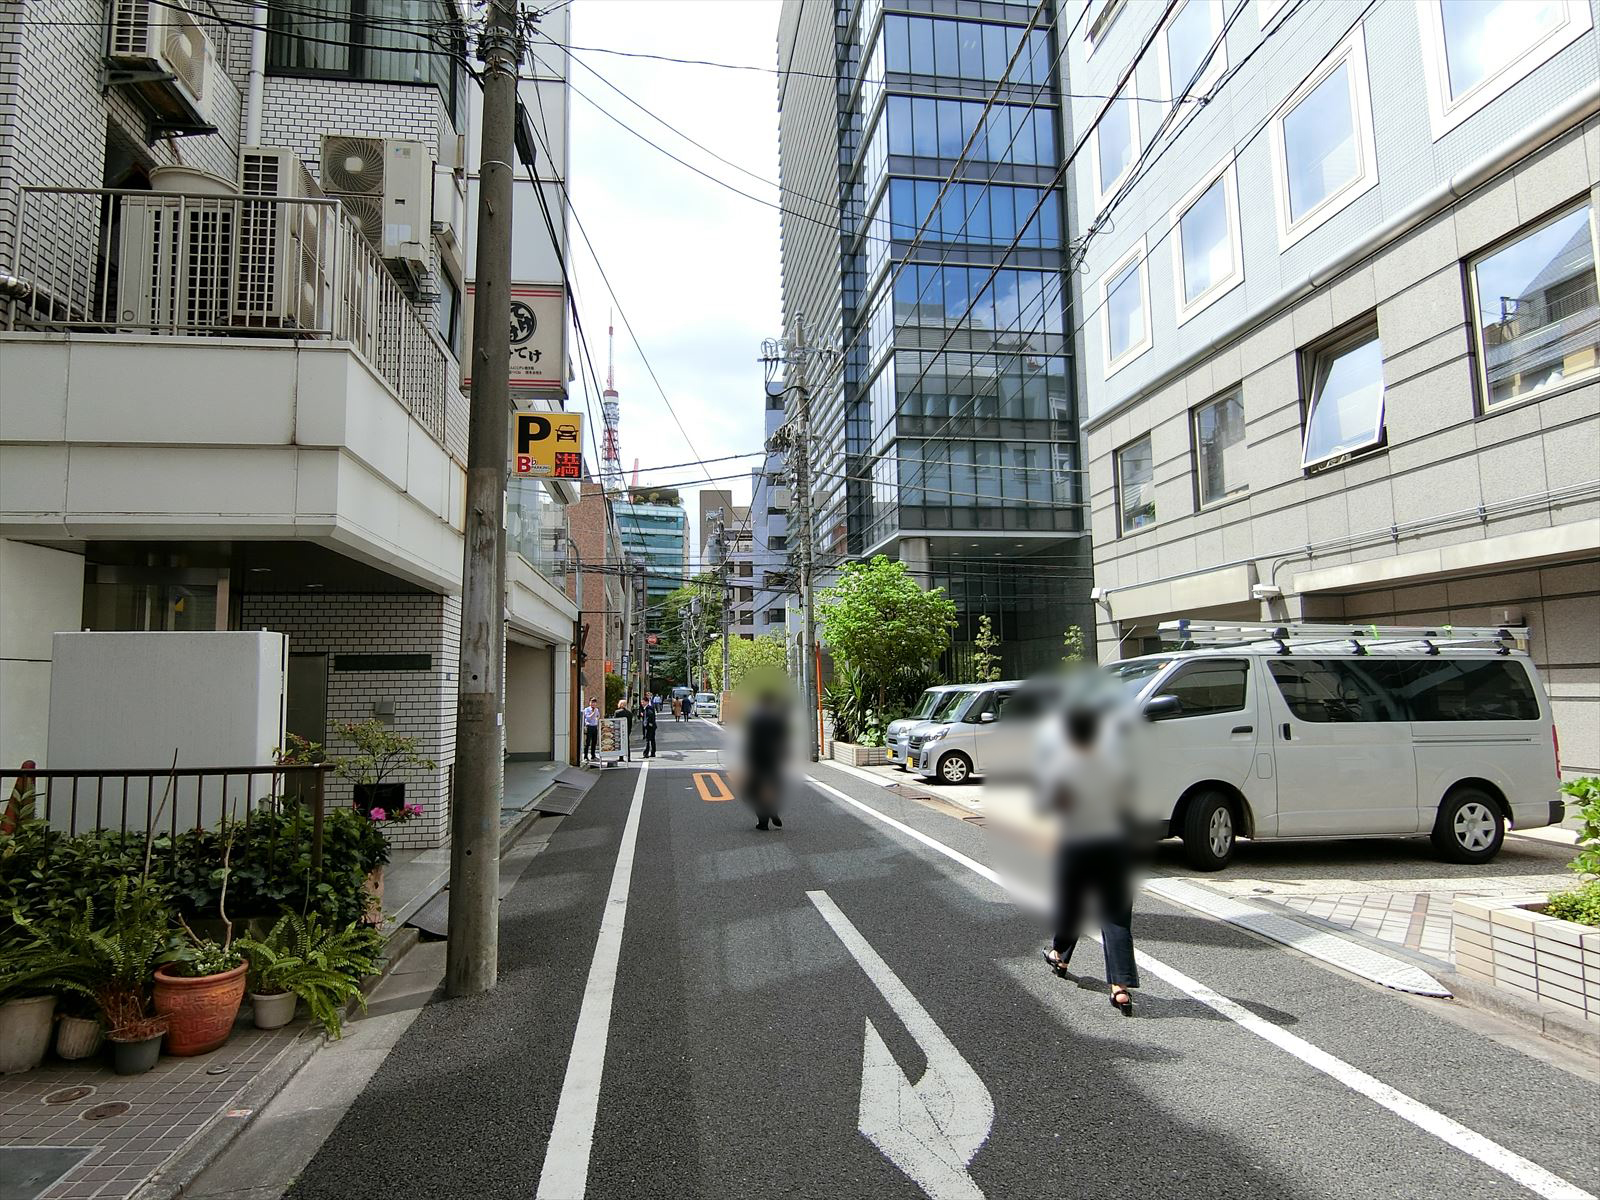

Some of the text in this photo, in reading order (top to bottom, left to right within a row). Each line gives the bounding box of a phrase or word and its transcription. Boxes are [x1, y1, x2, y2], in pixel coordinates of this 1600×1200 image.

[510, 347, 542, 363] てけ
[518, 416, 551, 453] P
[556, 453, 580, 477] 満
